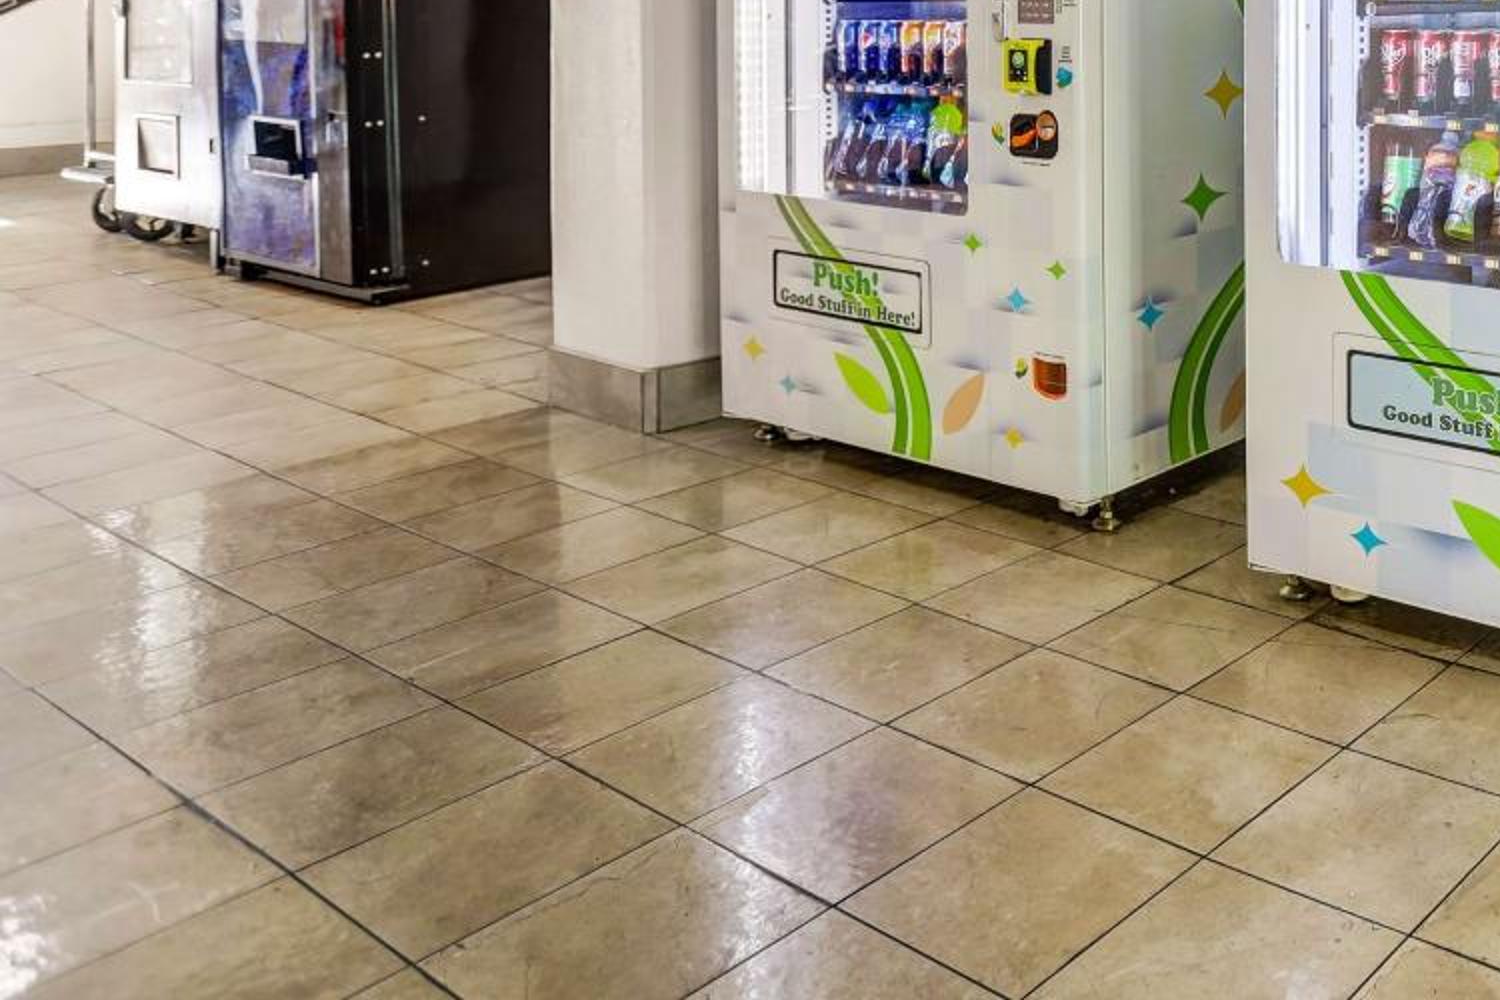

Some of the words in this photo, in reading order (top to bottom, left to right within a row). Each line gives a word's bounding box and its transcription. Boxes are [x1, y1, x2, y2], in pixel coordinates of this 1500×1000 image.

[812, 261, 880, 297] Push!
[779, 287, 814, 308] Good
[818, 295, 854, 315] Stuff
[856, 302, 871, 320] in
[876, 304, 916, 327] Here!
[1382, 405, 1434, 429] Good
[1439, 414, 1494, 440] Stuff
